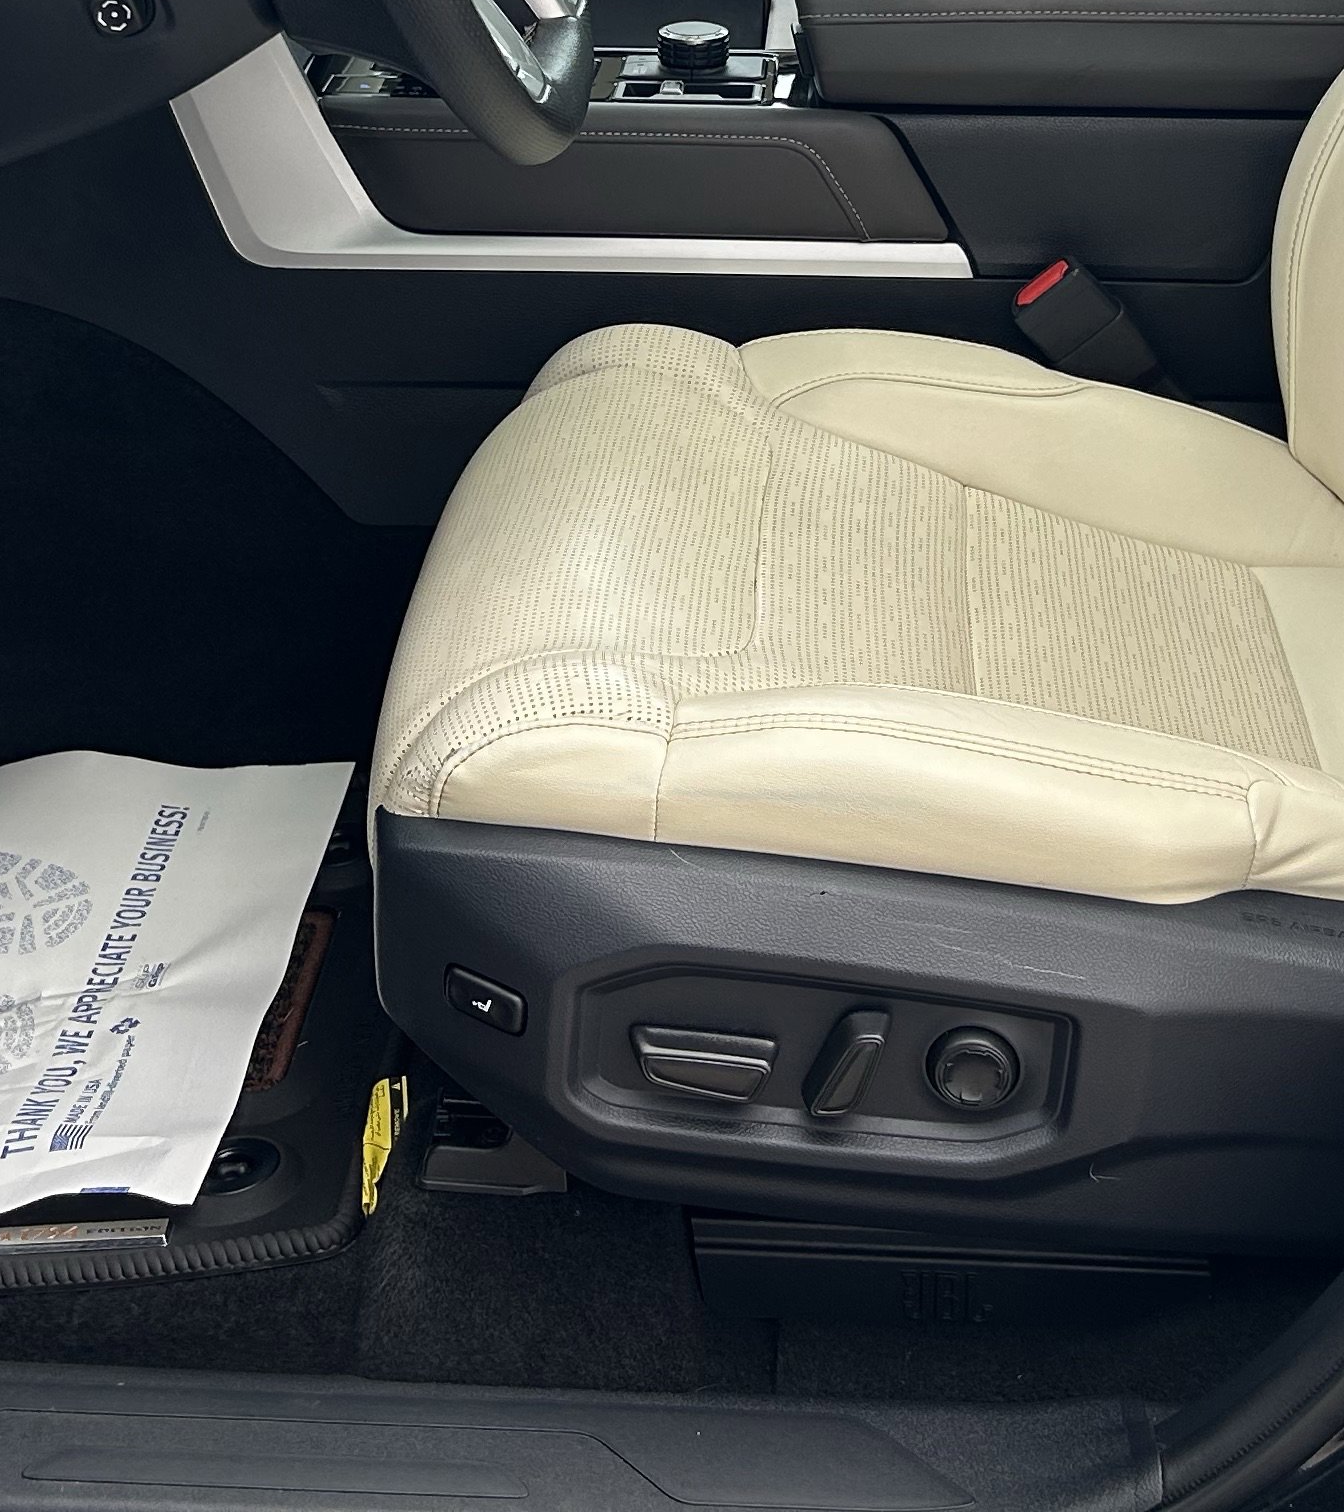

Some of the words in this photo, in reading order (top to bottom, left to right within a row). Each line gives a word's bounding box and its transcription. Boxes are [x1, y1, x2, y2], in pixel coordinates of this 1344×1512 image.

[130, 803, 191, 883] BUSINESS!
[109, 887, 158, 930] YOUR
[66, 933, 138, 1026] APPRECIATE
[51, 1028, 95, 1057] WE
[29, 1059, 88, 1096] YOU,
[63, 1103, 88, 1124] MADE
[83, 1078, 104, 1095] USA
[0, 1098, 60, 1160] THANK
